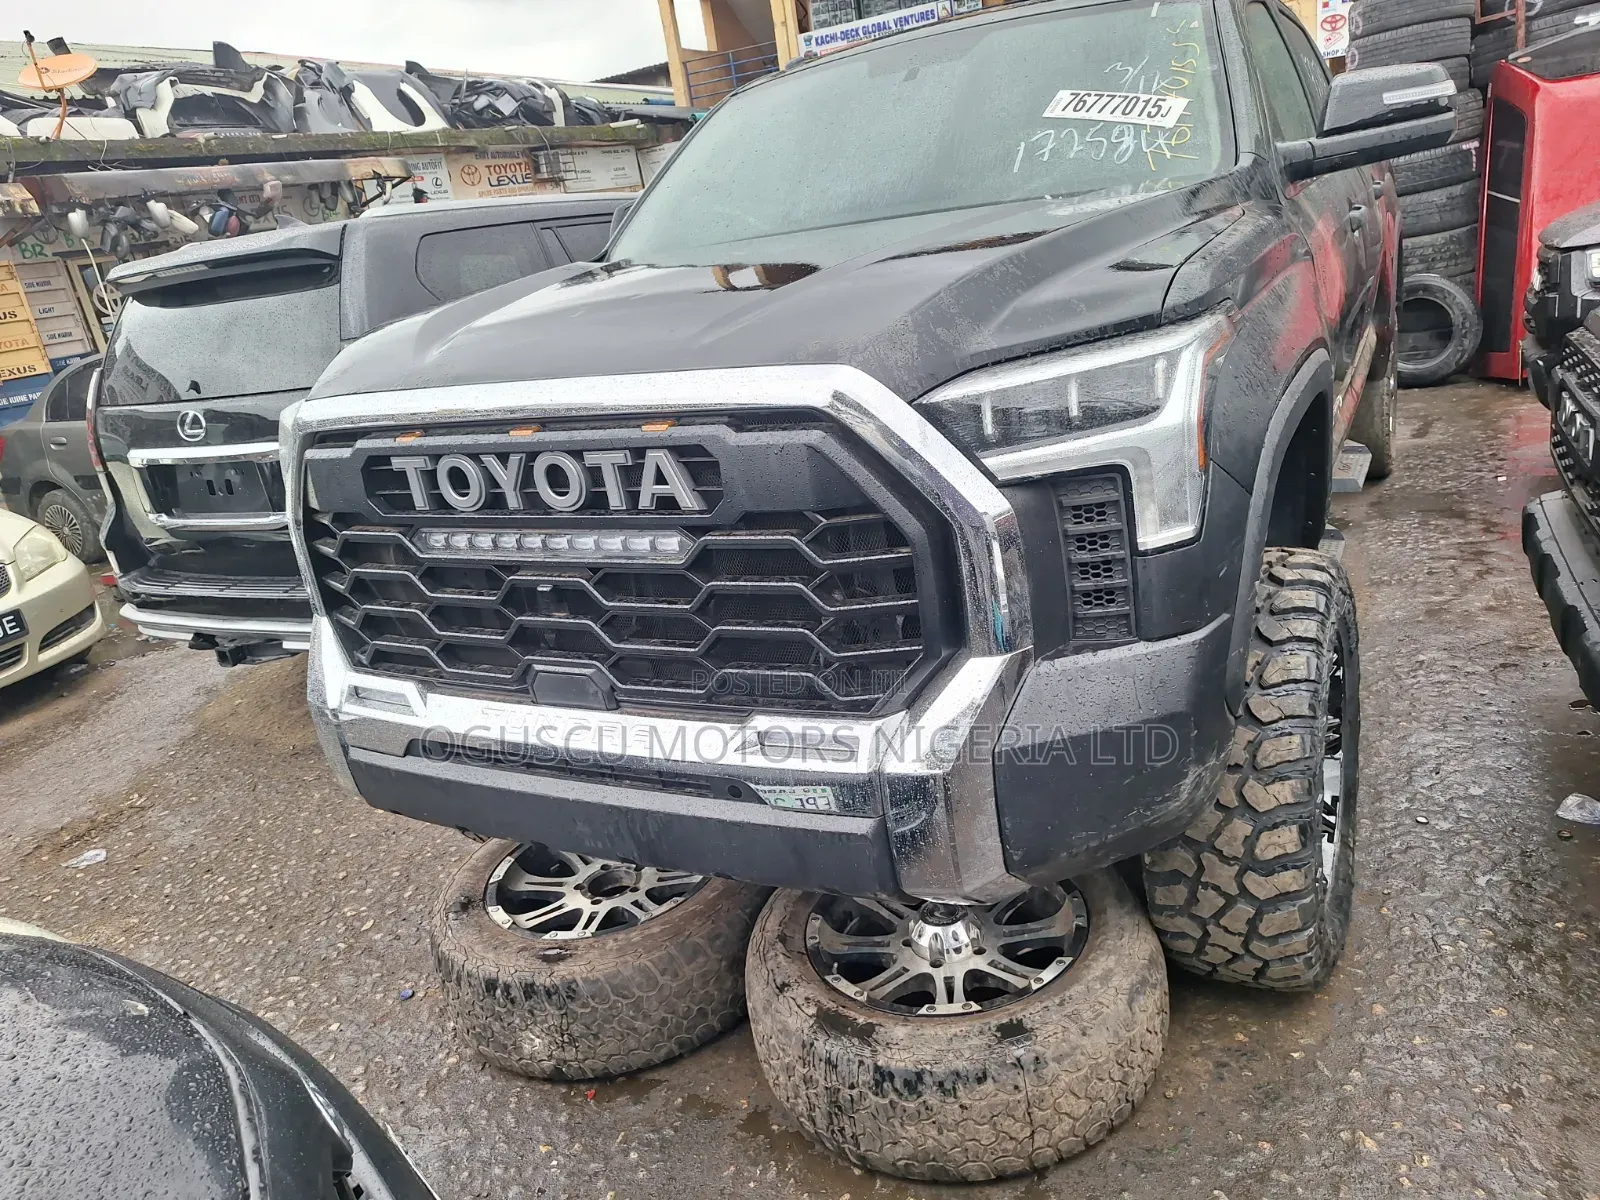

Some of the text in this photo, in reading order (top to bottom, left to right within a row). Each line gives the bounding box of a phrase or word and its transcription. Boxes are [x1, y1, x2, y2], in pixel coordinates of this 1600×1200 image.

[815, 9, 936, 47] KACHI-DECK GLOBAL VENTURES
[485, 160, 531, 176] TOYOTA
[38, 306, 55, 315] LIGHT
[390, 448, 702, 512] TOYOTA
